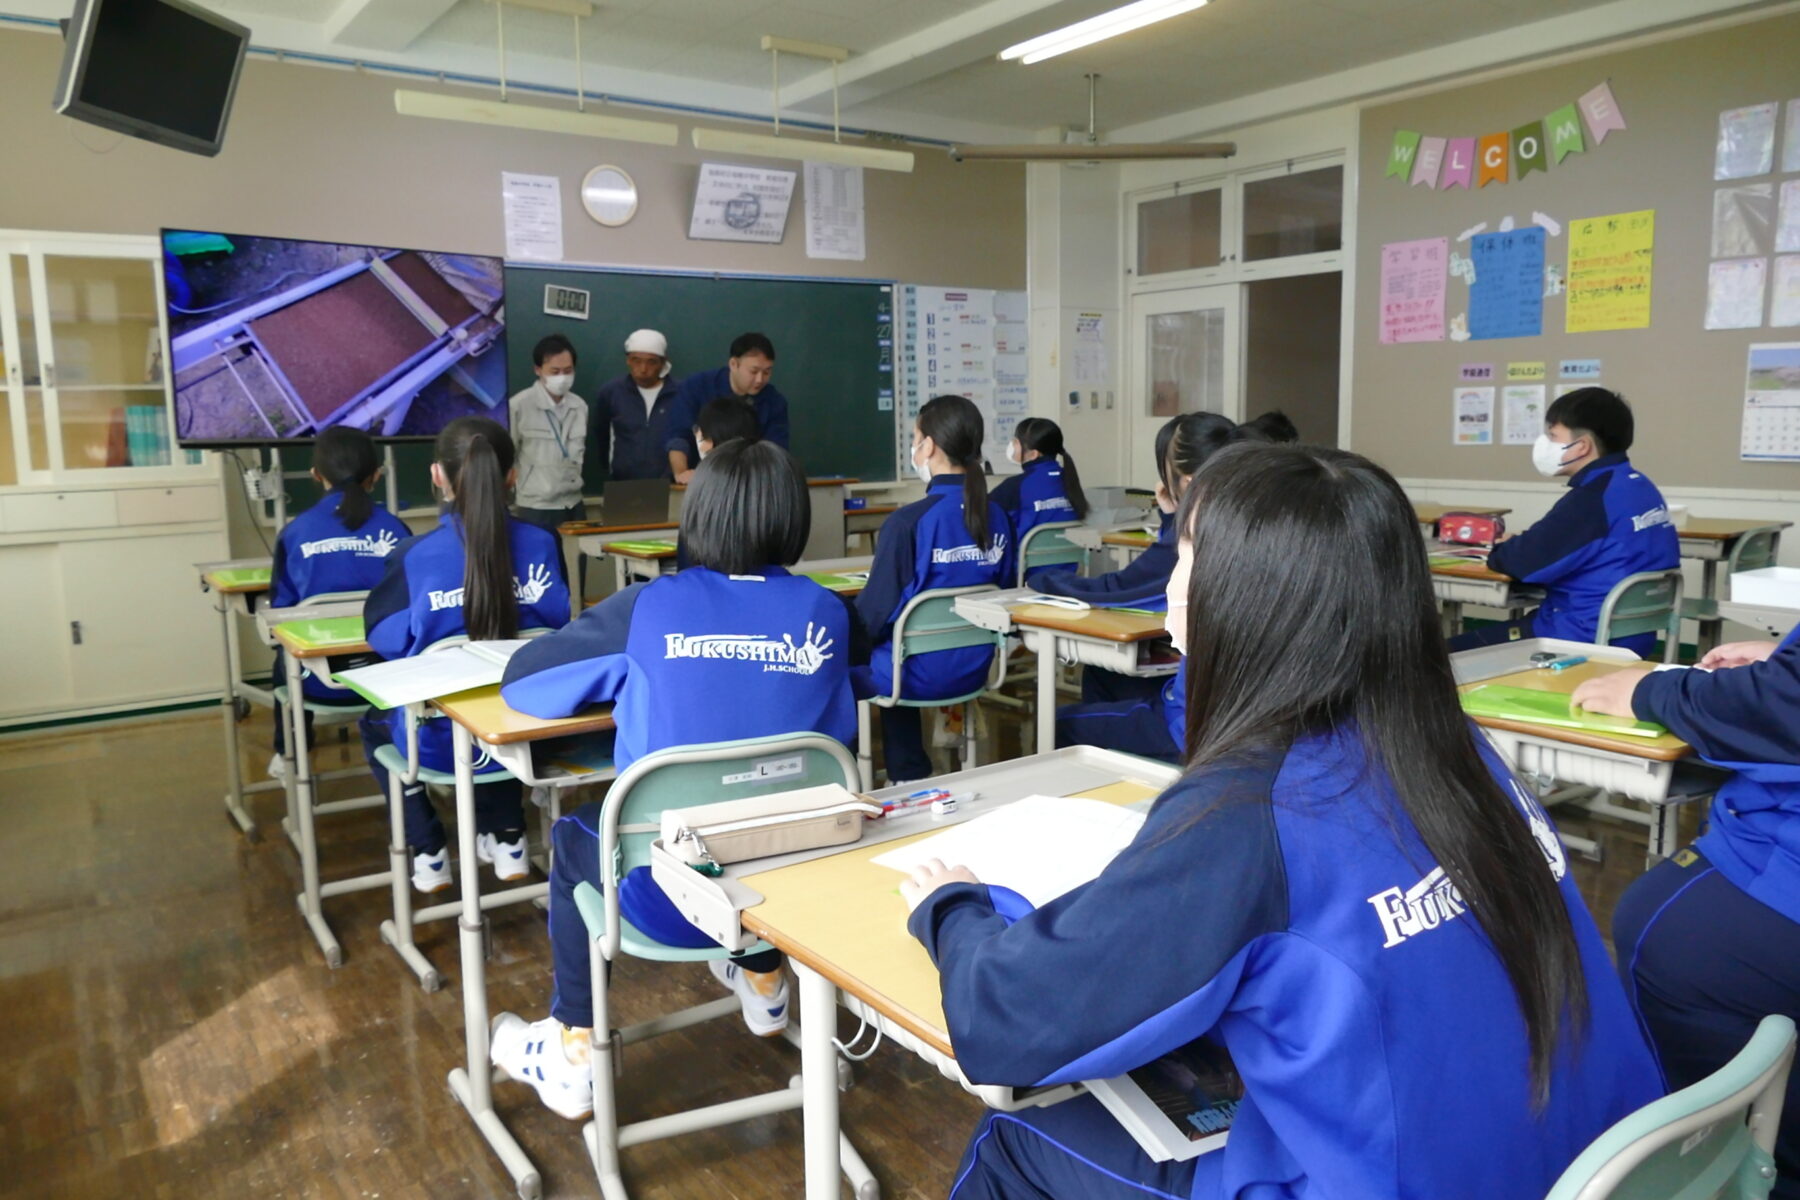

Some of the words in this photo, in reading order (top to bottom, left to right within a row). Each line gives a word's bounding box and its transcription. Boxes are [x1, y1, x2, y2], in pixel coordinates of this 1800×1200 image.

[1393, 98, 1611, 170] WELCOME
[932, 544, 1000, 563] FUKUSHIA
[664, 633, 813, 664] FUKUSHIMA
[761, 765, 768, 776] L
